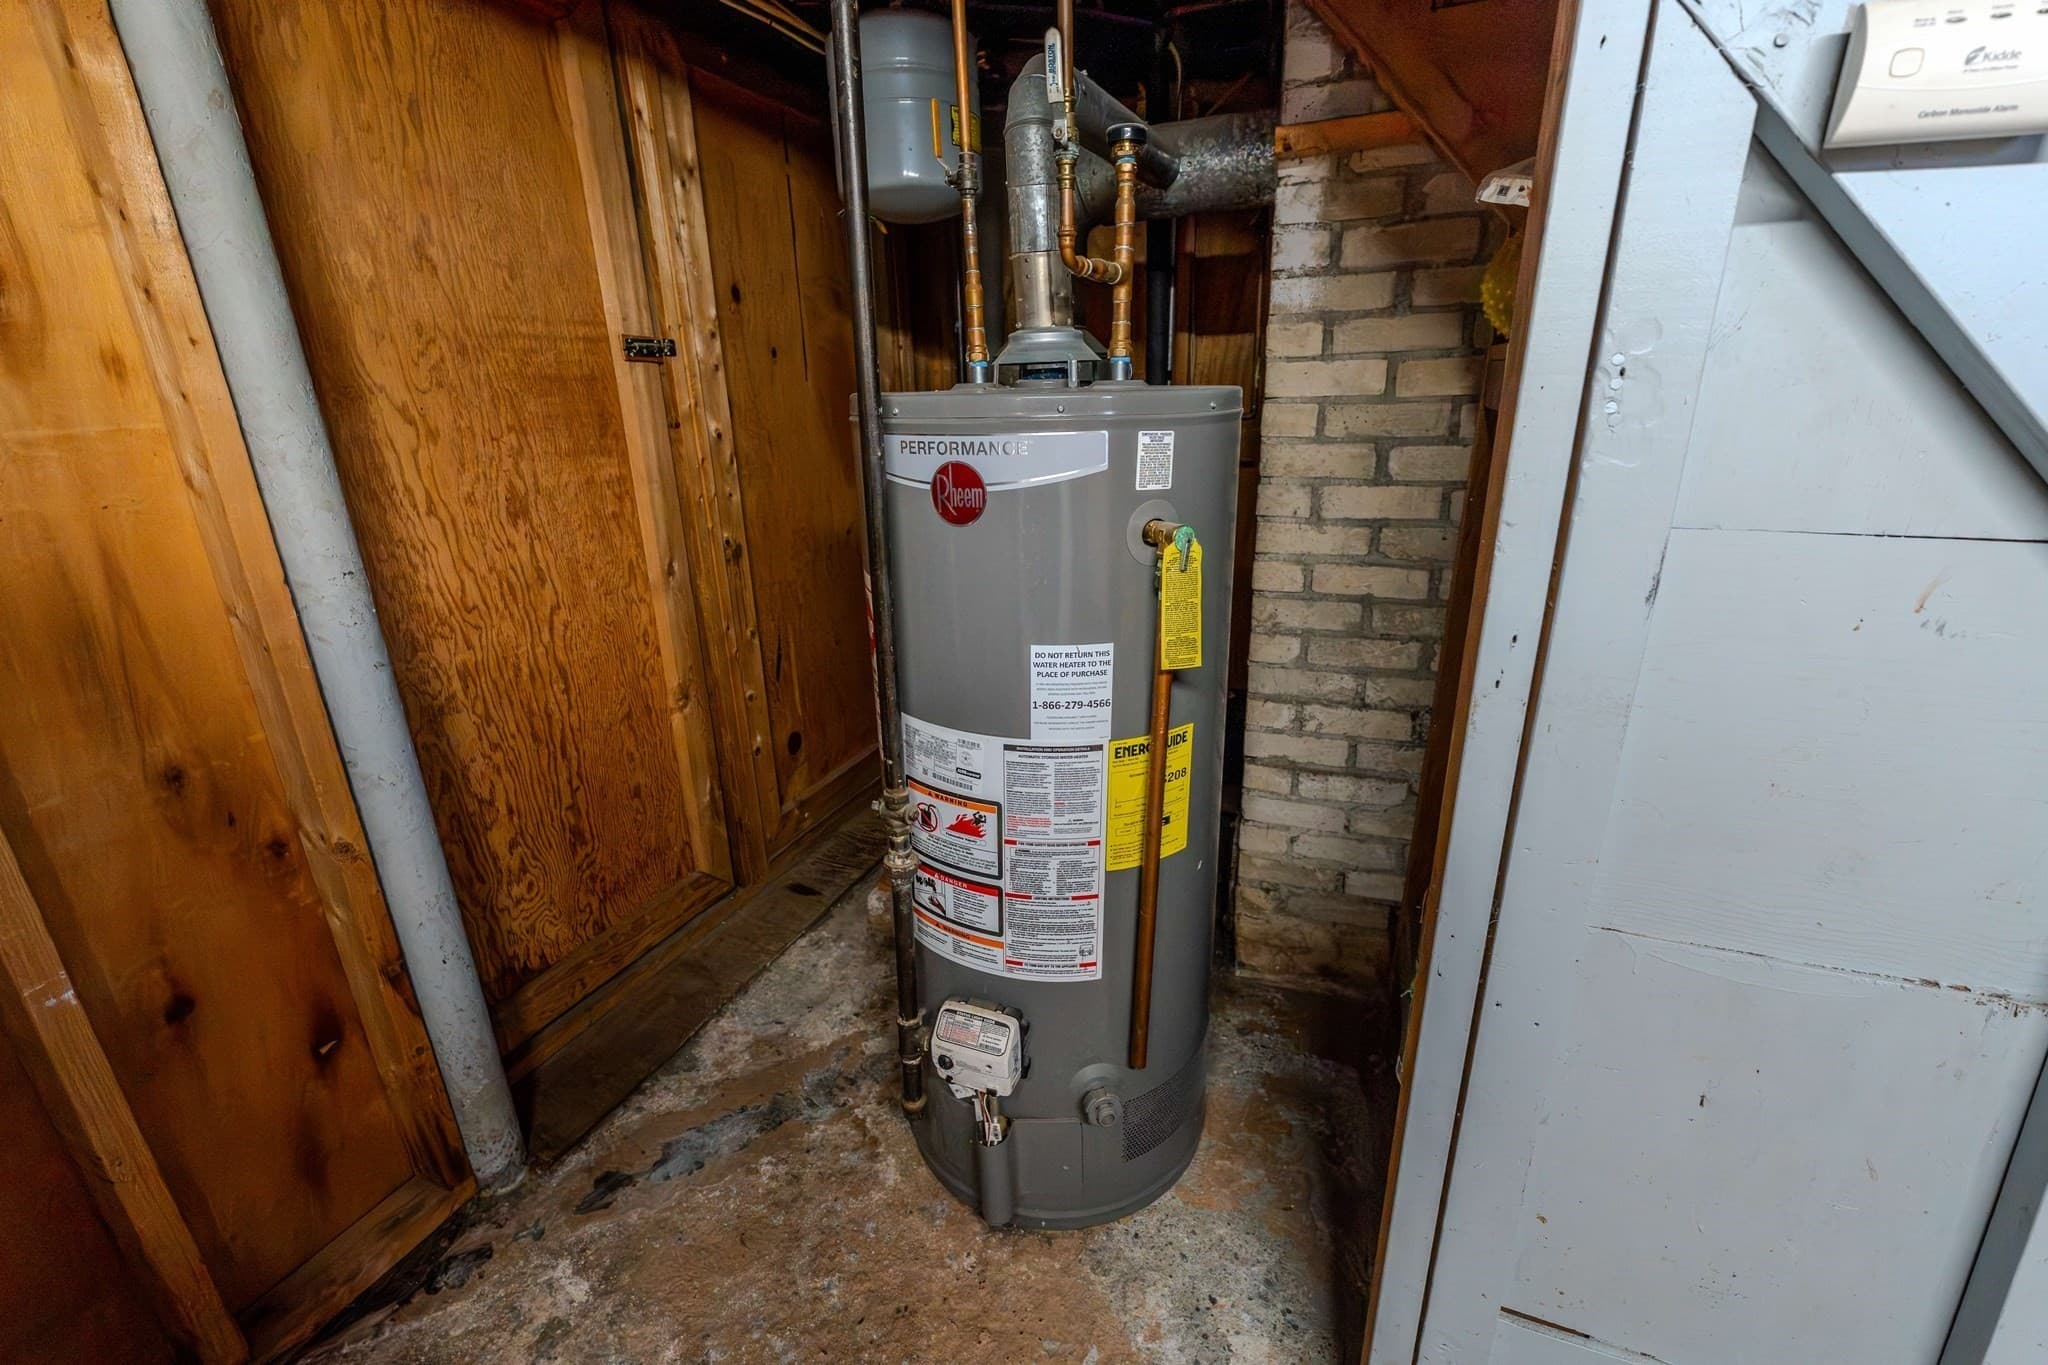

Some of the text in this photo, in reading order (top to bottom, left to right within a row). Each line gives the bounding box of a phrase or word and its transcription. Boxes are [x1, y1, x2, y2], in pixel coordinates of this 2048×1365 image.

[1982, 49, 2022, 62] Kidde
[900, 440, 1028, 456] PERFORMANCE
[936, 463, 983, 516] Rheem
[1065, 651, 1093, 659] RETURN
[1032, 698, 1111, 710] 1-866-279-4566
[935, 792, 968, 807] WARNING
[940, 874, 968, 889] DANGER
